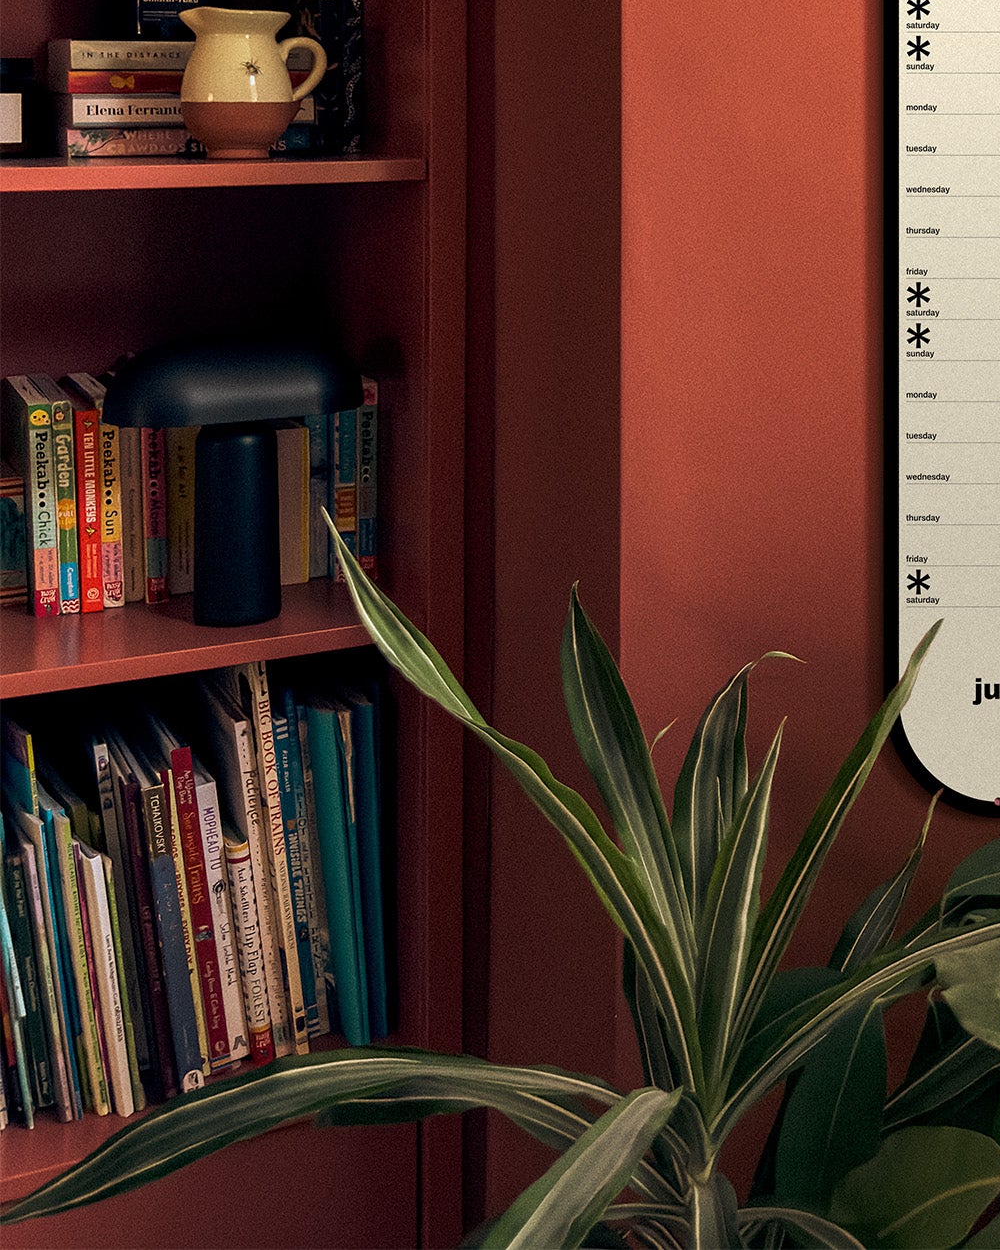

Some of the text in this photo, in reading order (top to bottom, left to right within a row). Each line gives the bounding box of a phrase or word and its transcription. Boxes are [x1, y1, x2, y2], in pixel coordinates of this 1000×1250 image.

[906, 21, 940, 30] saturday
[906, 62, 935, 71] sunday
[86, 105, 124, 116] Elena
[906, 103, 938, 112] monday
[906, 144, 937, 153] tuesday
[905, 185, 951, 194] wednesday
[905, 226, 941, 235] thursday
[905, 267, 929, 276] friday
[906, 308, 940, 317] saturday
[906, 349, 935, 358] sunday
[906, 390, 938, 399] monday
[906, 431, 937, 440] tuesday
[55, 433, 72, 487] Garden
[83, 431, 97, 523] TEN LITTLE MONKEYS
[905, 473, 951, 481] wednesday
[104, 510, 118, 536] Sun
[905, 513, 941, 522] thursday
[37, 511, 52, 546] Chick
[905, 554, 929, 563] friday
[905, 596, 940, 604] saturday
[258, 700, 271, 726] BIG
[261, 731, 278, 775] BOOK
[266, 779, 279, 801] OF
[149, 794, 166, 854] TCHAIKOVSKY
[268, 800, 286, 856] TRAINS
[202, 807, 222, 870] MOPHEAD TU
[183, 812, 205, 905] See inside Trains
[287, 833, 307, 923] INVISIBLE THINGS
[242, 925, 256, 948] Flip
[246, 951, 260, 976] Flap
[250, 979, 269, 1025] FOREST
